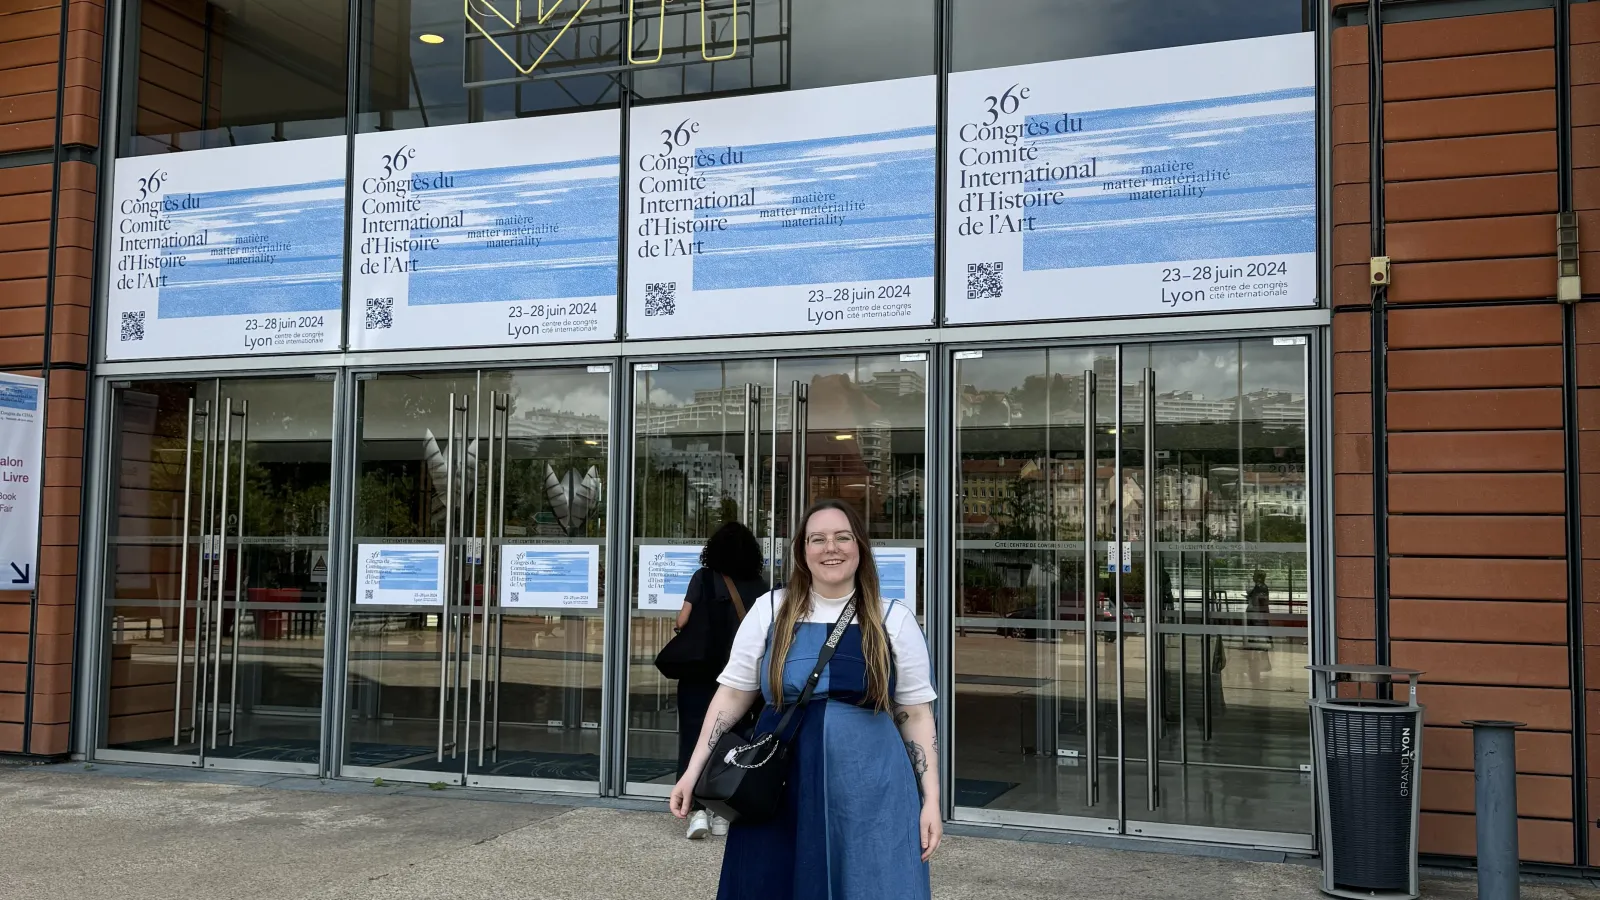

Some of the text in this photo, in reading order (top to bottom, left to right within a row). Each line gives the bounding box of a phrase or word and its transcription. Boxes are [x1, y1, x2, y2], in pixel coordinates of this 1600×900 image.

[959, 113, 1082, 146] Congrès du
[640, 147, 743, 174] Congrès du
[959, 143, 1038, 166] Comité
[960, 158, 1096, 188] International
[1141, 160, 1194, 174] matière
[362, 172, 454, 198] Congrès du
[639, 173, 706, 194] Comité
[1102, 169, 1230, 191] matter matérialité
[639, 188, 755, 214] International
[792, 192, 835, 204] matière
[1129, 184, 1206, 201] materiality
[121, 194, 200, 218] Congrès du
[362, 196, 420, 214] Comité
[760, 200, 866, 218] matter matérialité
[958, 190, 1064, 214] d'Histoire
[120, 215, 171, 234] Comité
[362, 210, 464, 234] International
[495, 215, 534, 226] matière
[638, 217, 728, 236] d'Histoire
[782, 214, 846, 228] materiality
[958, 214, 1036, 236] de l'Art
[120, 230, 208, 251] International
[235, 234, 268, 244] matière
[468, 224, 559, 239] matter matérialité
[210, 242, 291, 256] matter matérialité
[361, 236, 440, 254] d'Histoire
[486, 236, 542, 249] materiality
[638, 239, 704, 258] de l'Art
[118, 254, 186, 271] d'Histoire
[227, 254, 276, 266] materiality
[360, 257, 418, 274] de l'Art
[118, 274, 168, 290] de l'Art
[1214, 265, 1243, 284] juin
[1247, 262, 1287, 278] 2024
[1253, 280, 1288, 290] congrès
[850, 288, 874, 304] juin
[878, 285, 911, 298] 2024
[1162, 288, 1204, 306] Lyon
[1210, 289, 1288, 300] cité internationale
[546, 304, 566, 318] juin
[568, 302, 596, 315] 2024
[808, 308, 843, 325] Lyon
[278, 318, 296, 332] juin
[298, 316, 324, 328] 2024
[508, 322, 539, 339] Lyon
[244, 335, 272, 350] Lyon
[0, 456, 23, 467] alon
[3, 472, 29, 482] Livre
[1401, 728, 1410, 796] GRANDLYON
